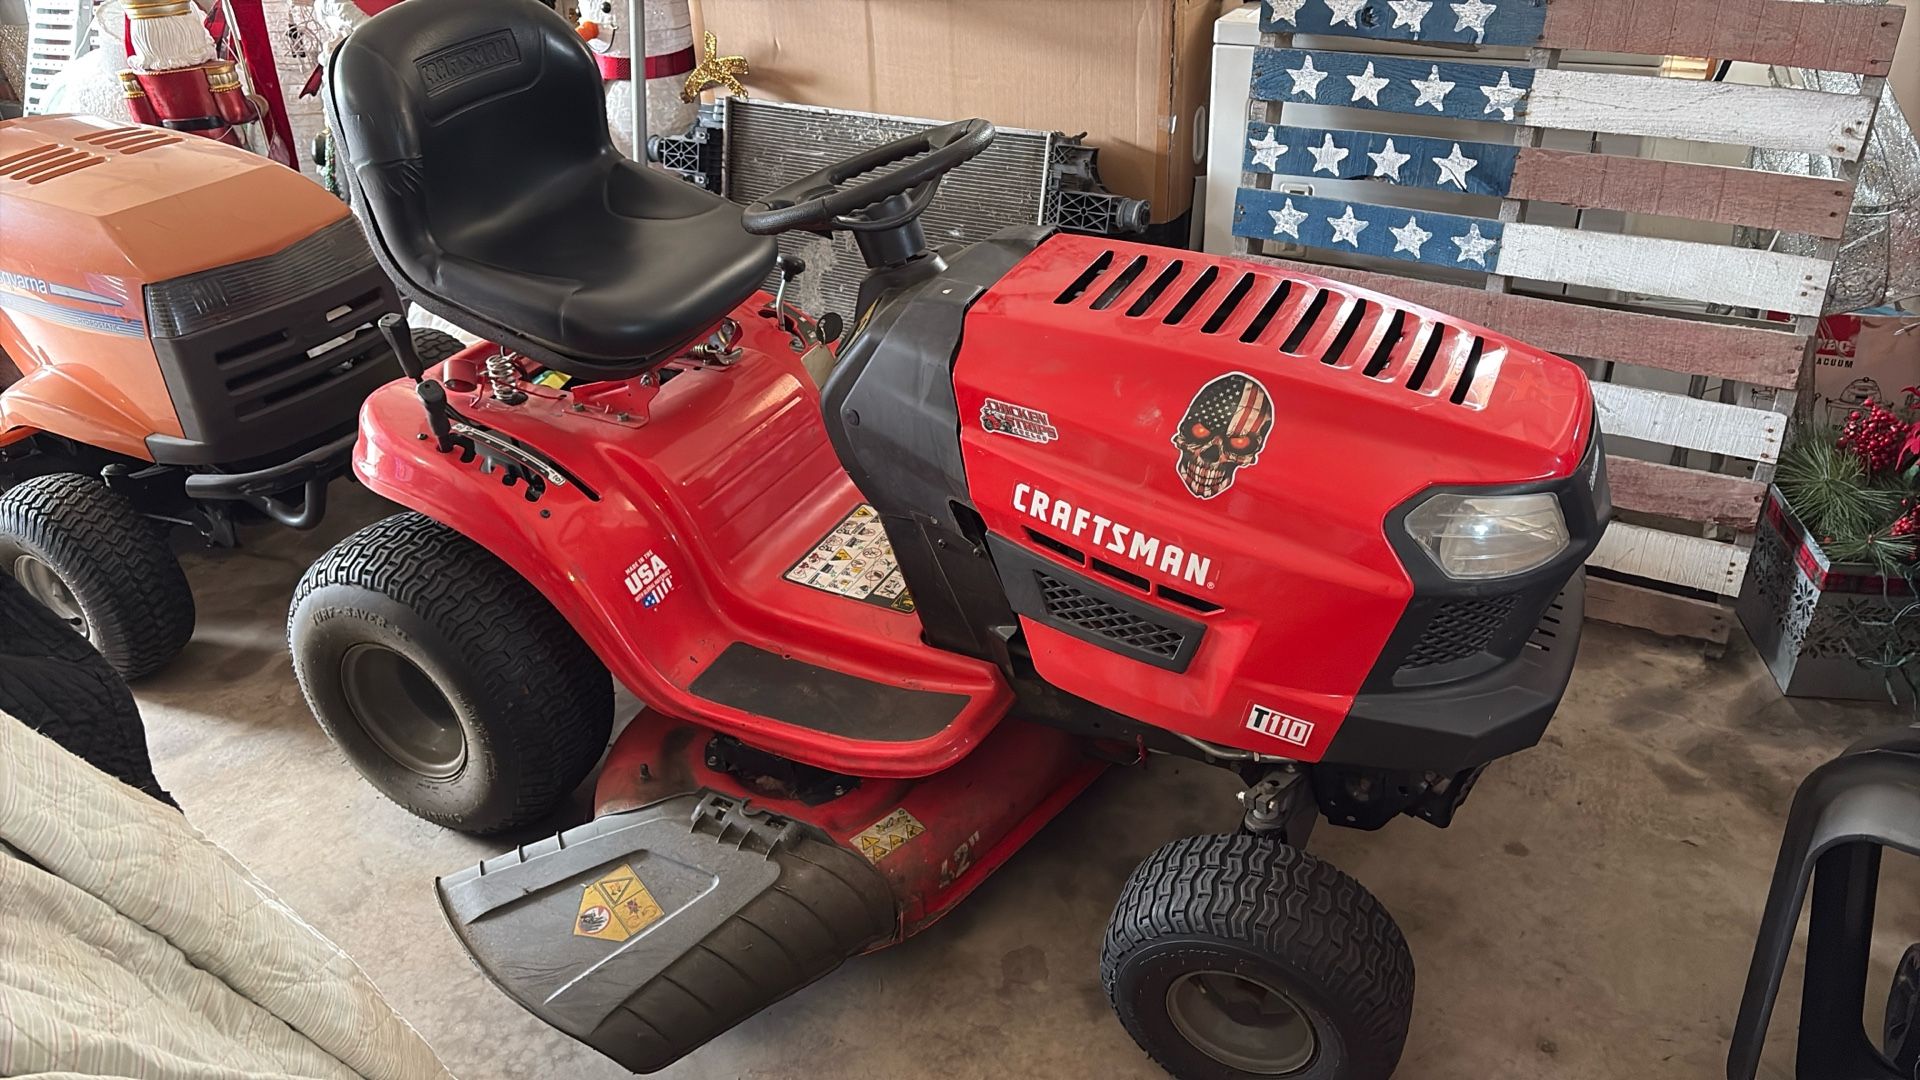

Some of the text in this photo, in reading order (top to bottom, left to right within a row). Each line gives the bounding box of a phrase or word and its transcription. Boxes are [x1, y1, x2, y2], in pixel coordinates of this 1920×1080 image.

[1816, 358, 1853, 368] ACUUM
[1013, 483, 1210, 586] CRAFTSMAN
[624, 554, 668, 595] USA
[1253, 706, 1309, 742] T110
